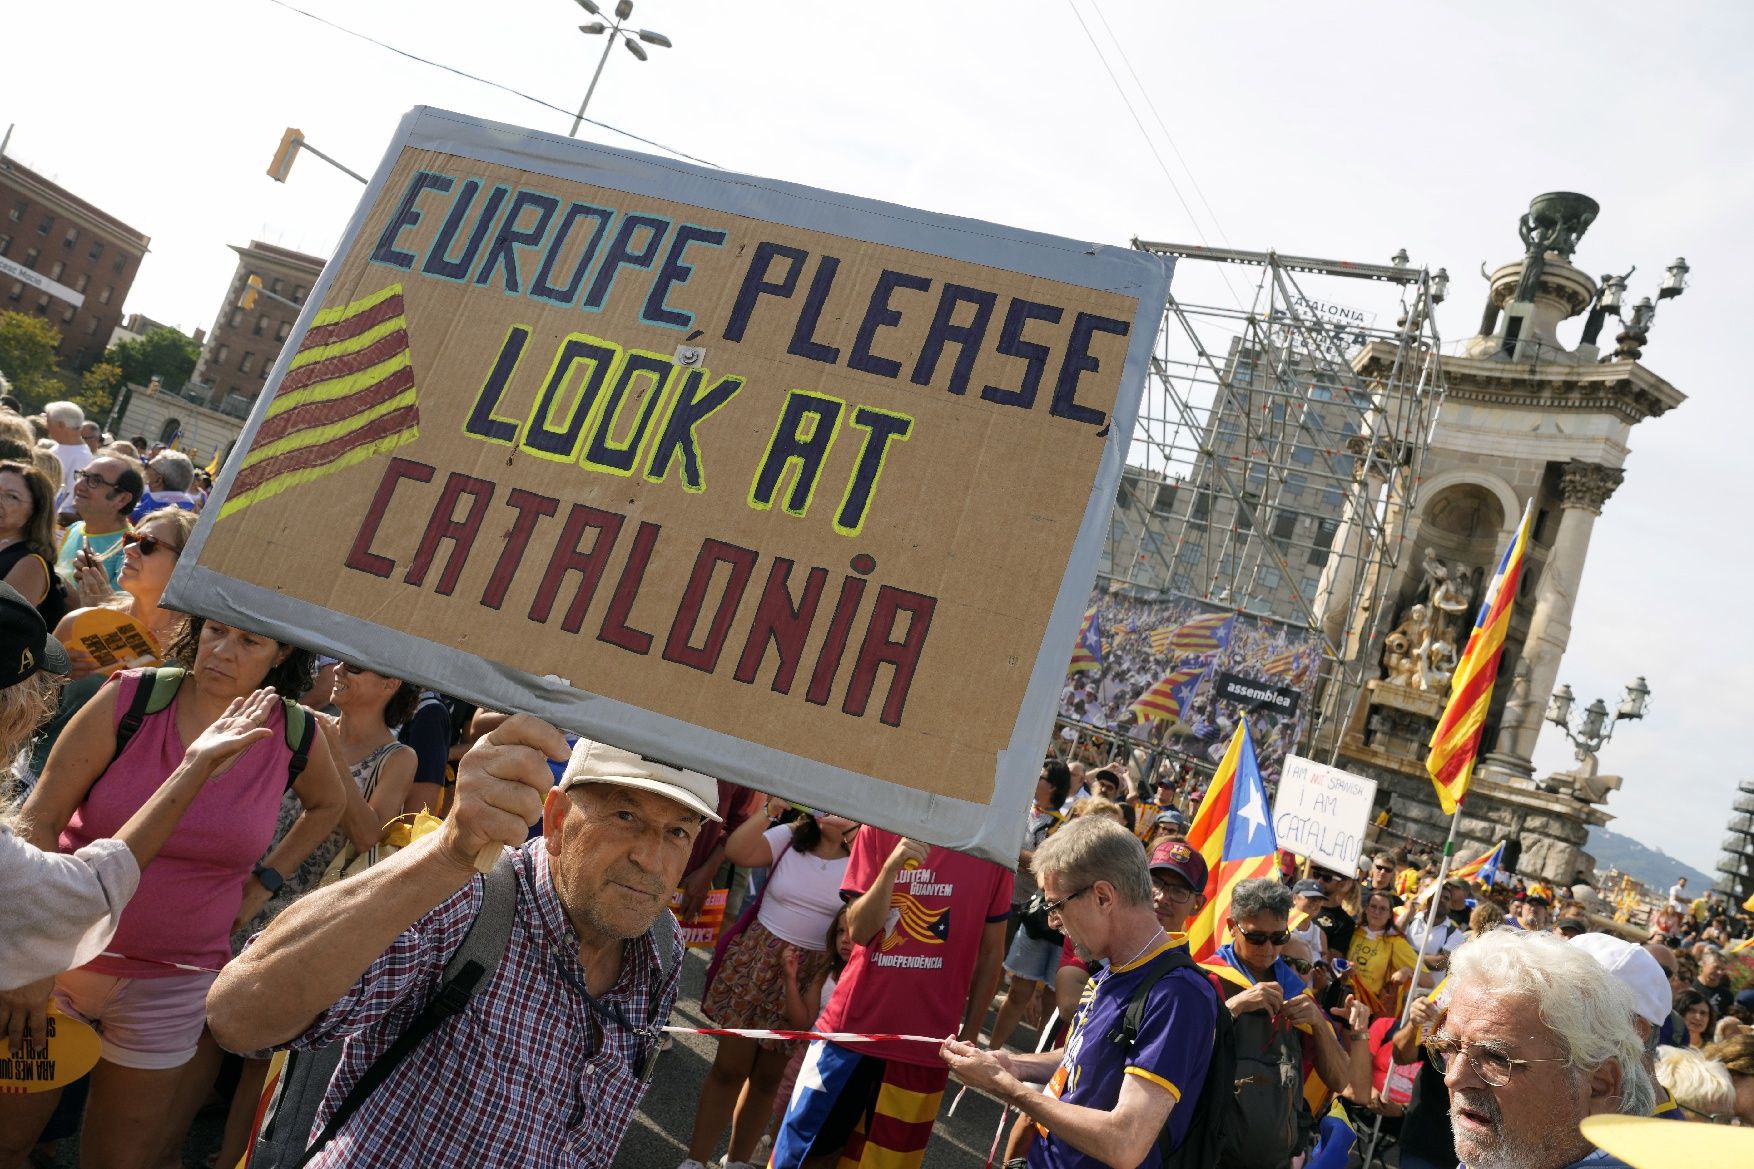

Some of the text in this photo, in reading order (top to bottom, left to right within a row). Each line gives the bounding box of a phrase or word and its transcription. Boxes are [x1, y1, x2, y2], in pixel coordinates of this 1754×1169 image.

[1289, 295, 1364, 322] AALONIA
[463, 322, 915, 537] LOOK AT
[1227, 682, 1291, 707] assemblea
[1292, 766, 1308, 780] AM
[1313, 792, 1337, 816] AM
[1276, 812, 1363, 863] CATALAN
[909, 882, 954, 897] GUANYEM
[878, 953, 943, 969] INDEPENDÈNCIA
[1355, 943, 1378, 957] SOS
[15, 1060, 34, 1082] MÉS
[36, 1060, 56, 1081] ARA
